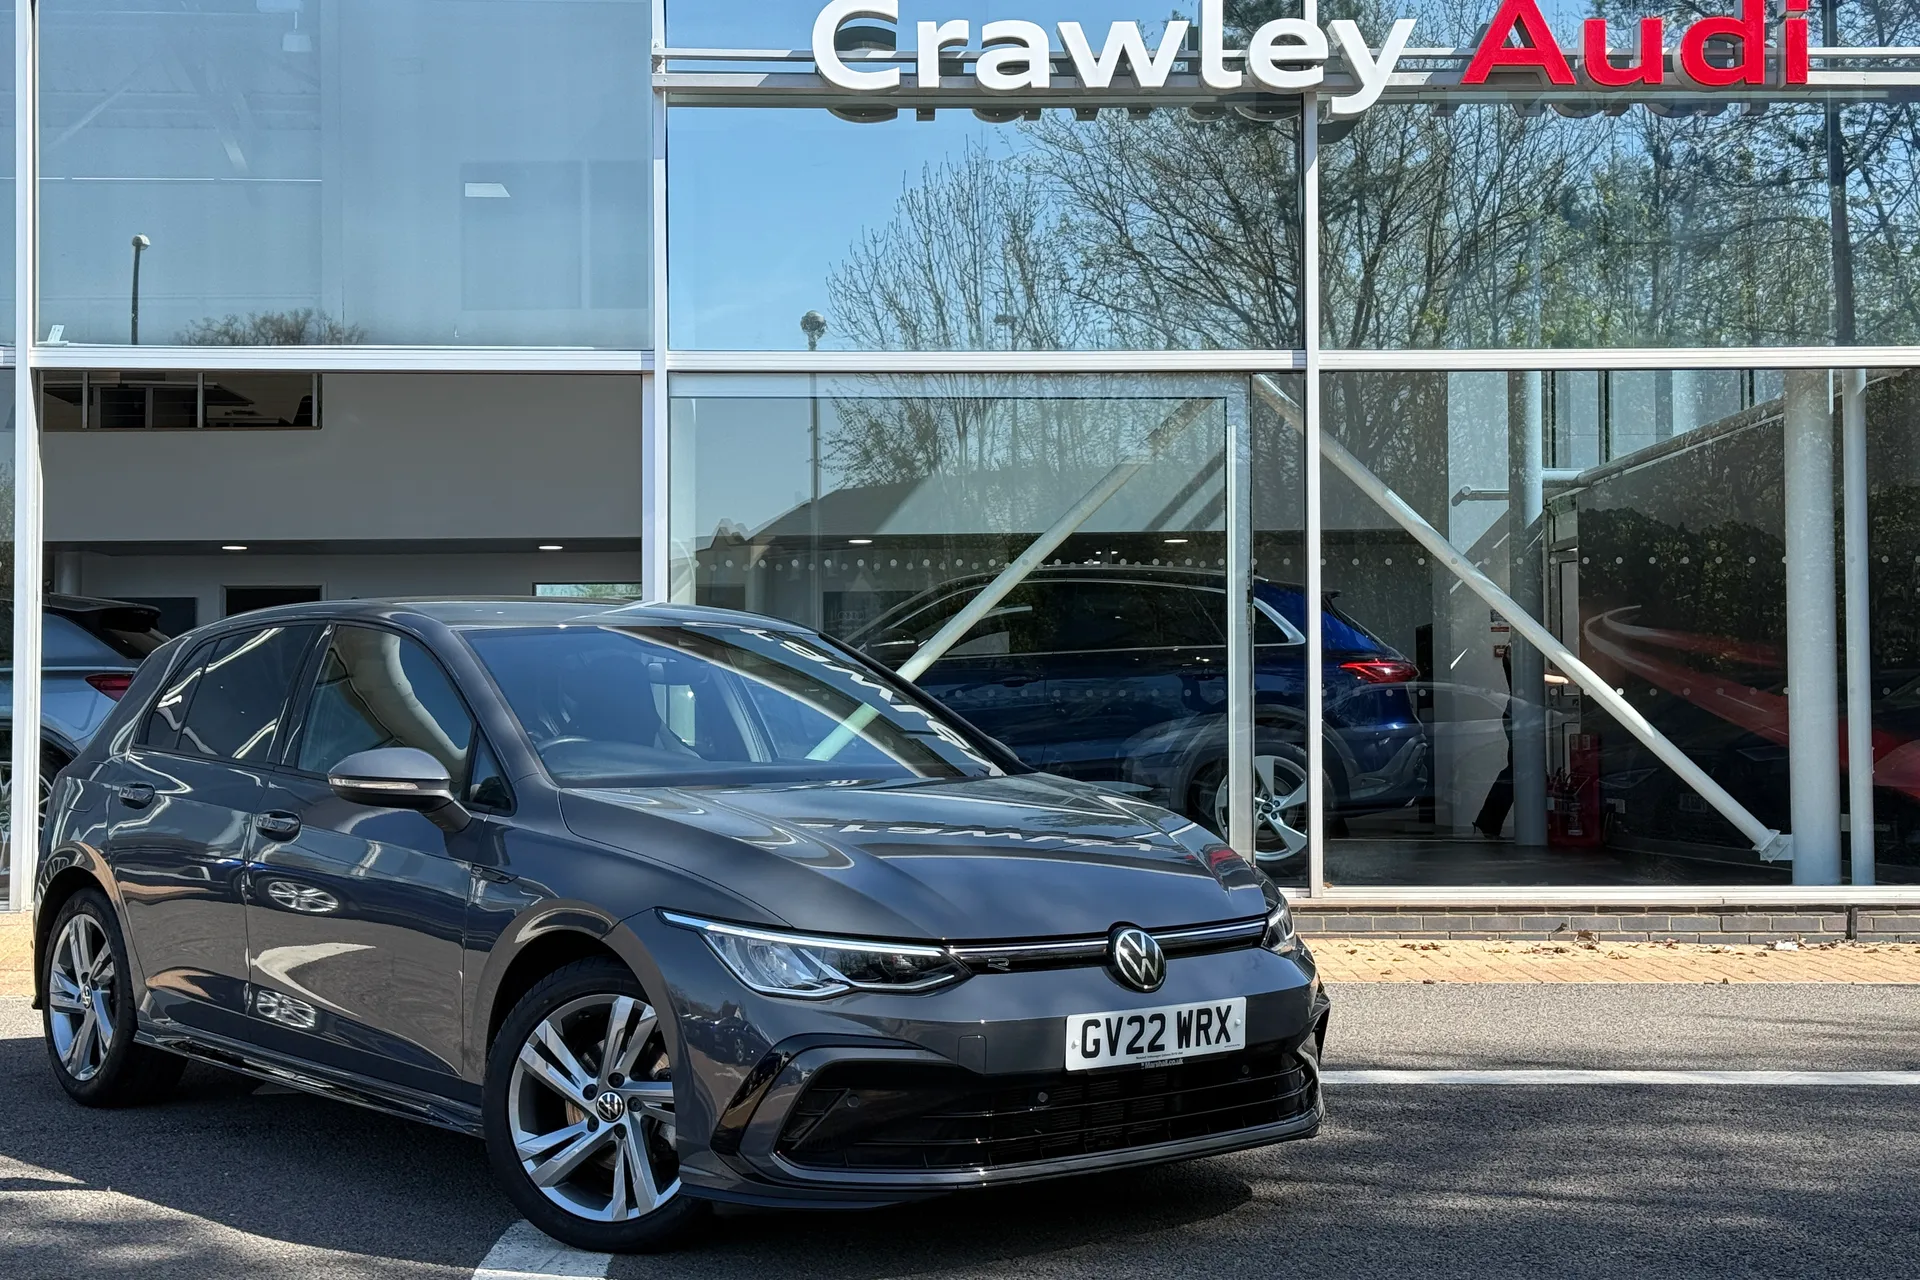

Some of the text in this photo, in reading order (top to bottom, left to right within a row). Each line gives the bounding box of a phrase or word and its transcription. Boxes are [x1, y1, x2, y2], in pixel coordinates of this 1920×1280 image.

[812, 0, 1809, 114] Crawley Audi
[1081, 1004, 1232, 1059] GV22 WRX
